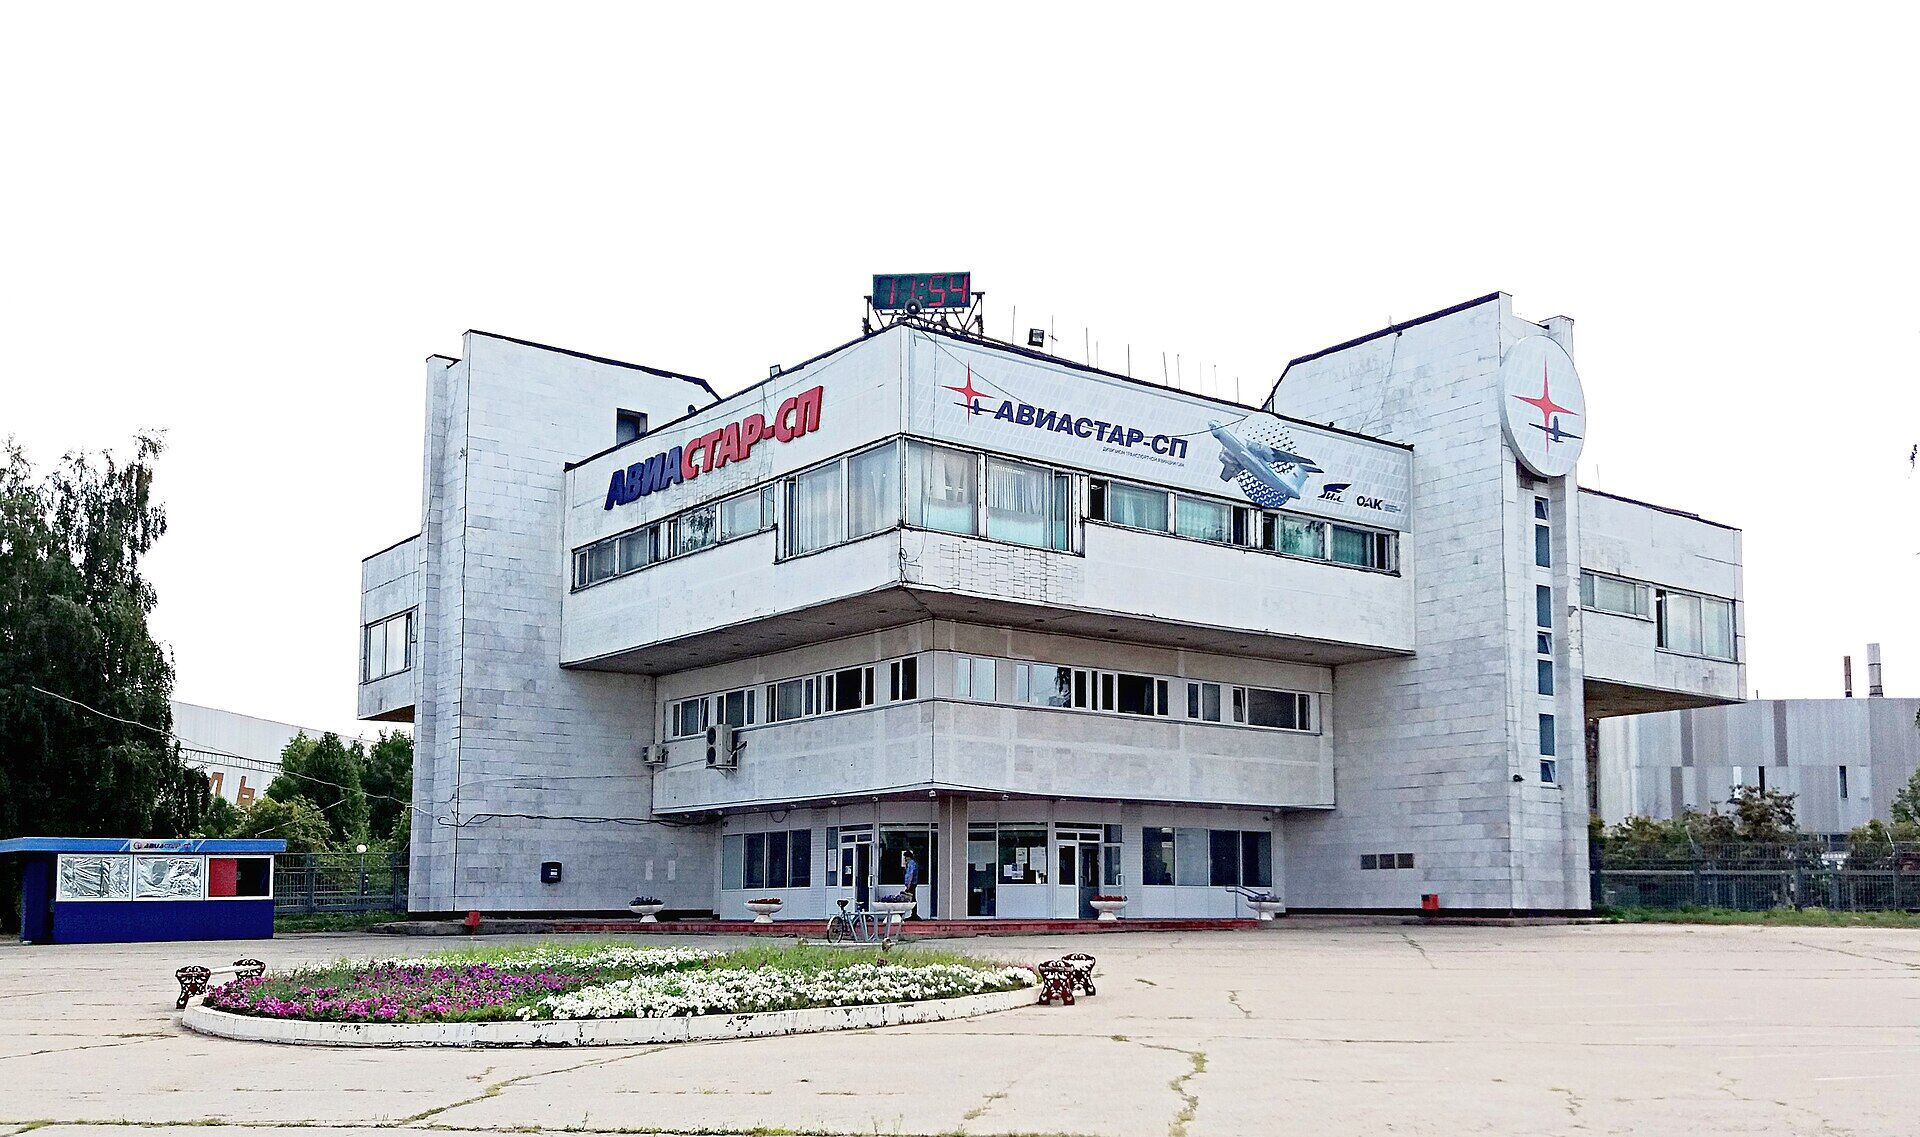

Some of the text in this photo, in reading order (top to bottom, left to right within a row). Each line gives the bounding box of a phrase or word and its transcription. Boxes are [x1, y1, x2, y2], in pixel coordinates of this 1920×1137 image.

[604, 385, 824, 511] АВИАСТАР-СП
[994, 400, 1188, 460] АВИАСТАР-СП
[1356, 495, 1383, 511] ОАК
